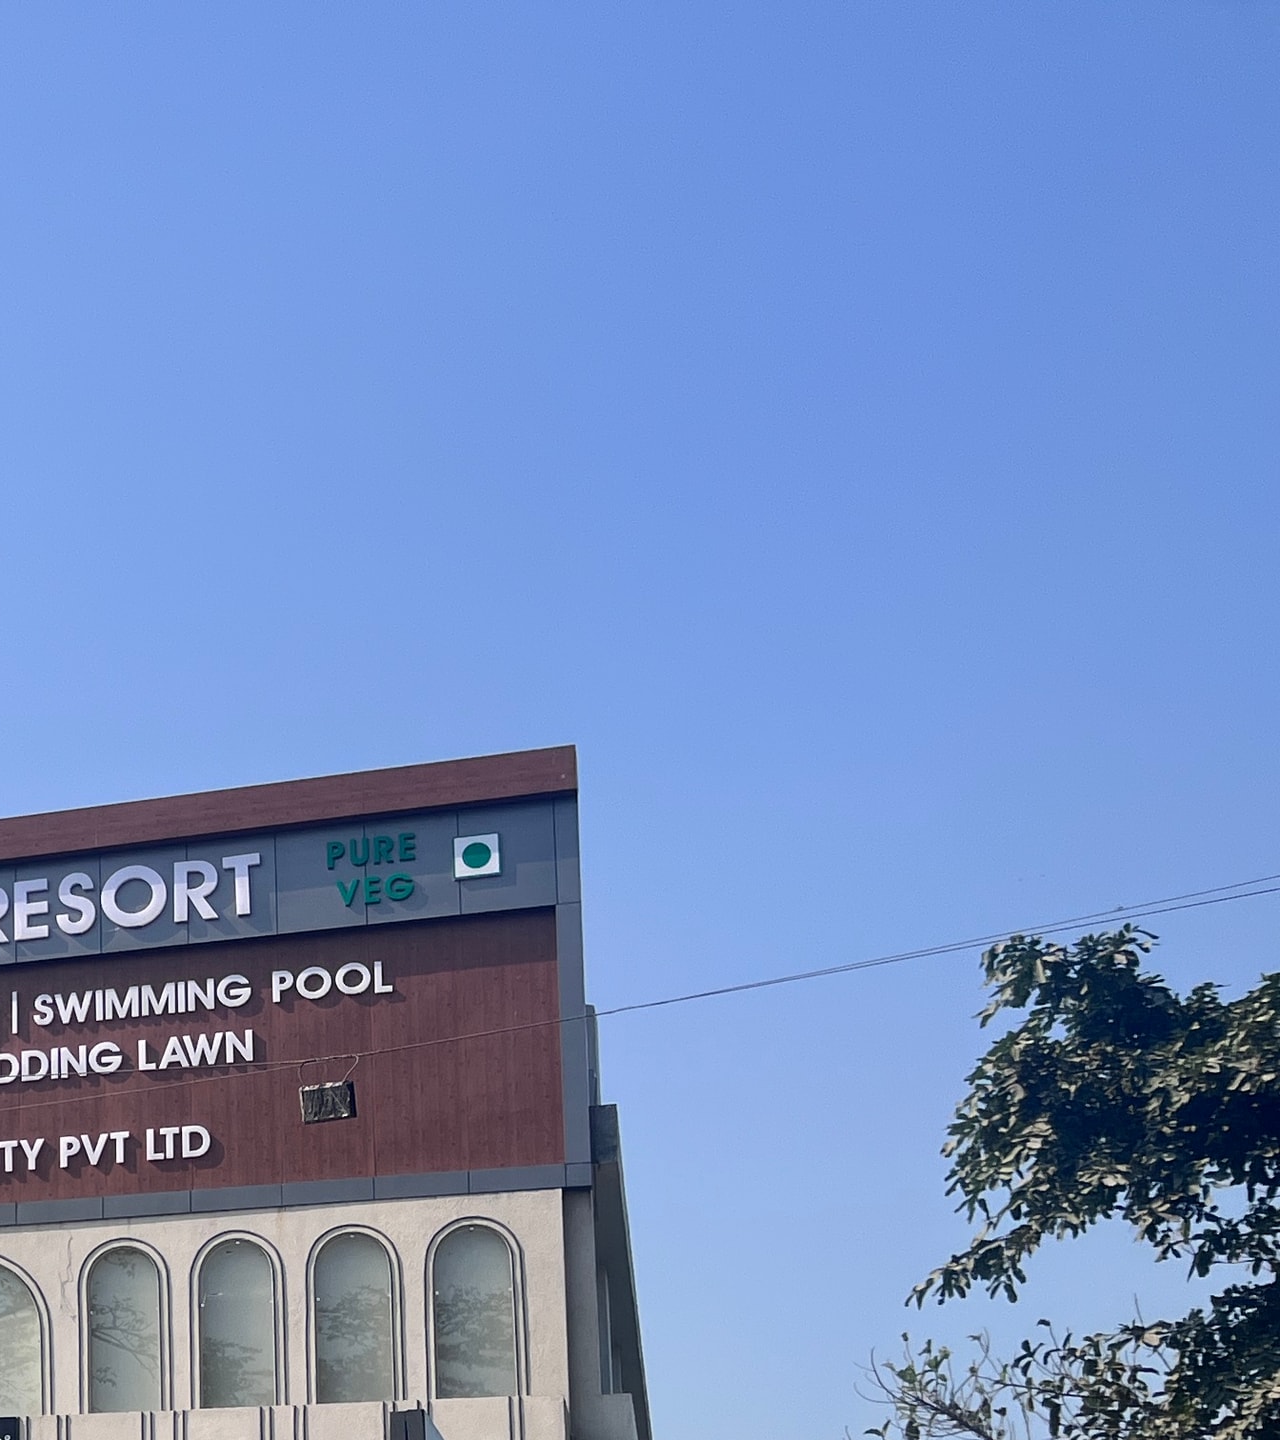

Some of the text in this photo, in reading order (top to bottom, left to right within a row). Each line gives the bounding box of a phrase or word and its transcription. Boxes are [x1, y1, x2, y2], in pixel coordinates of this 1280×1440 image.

[326, 832, 416, 869] PURE
[337, 873, 416, 906] VEG
[32, 974, 252, 1027] SWIMMING
[272, 960, 393, 1003] POOL
[138, 1030, 255, 1071] LAWN
[59, 1131, 130, 1169] PVT
[146, 1125, 211, 1162] LTD
